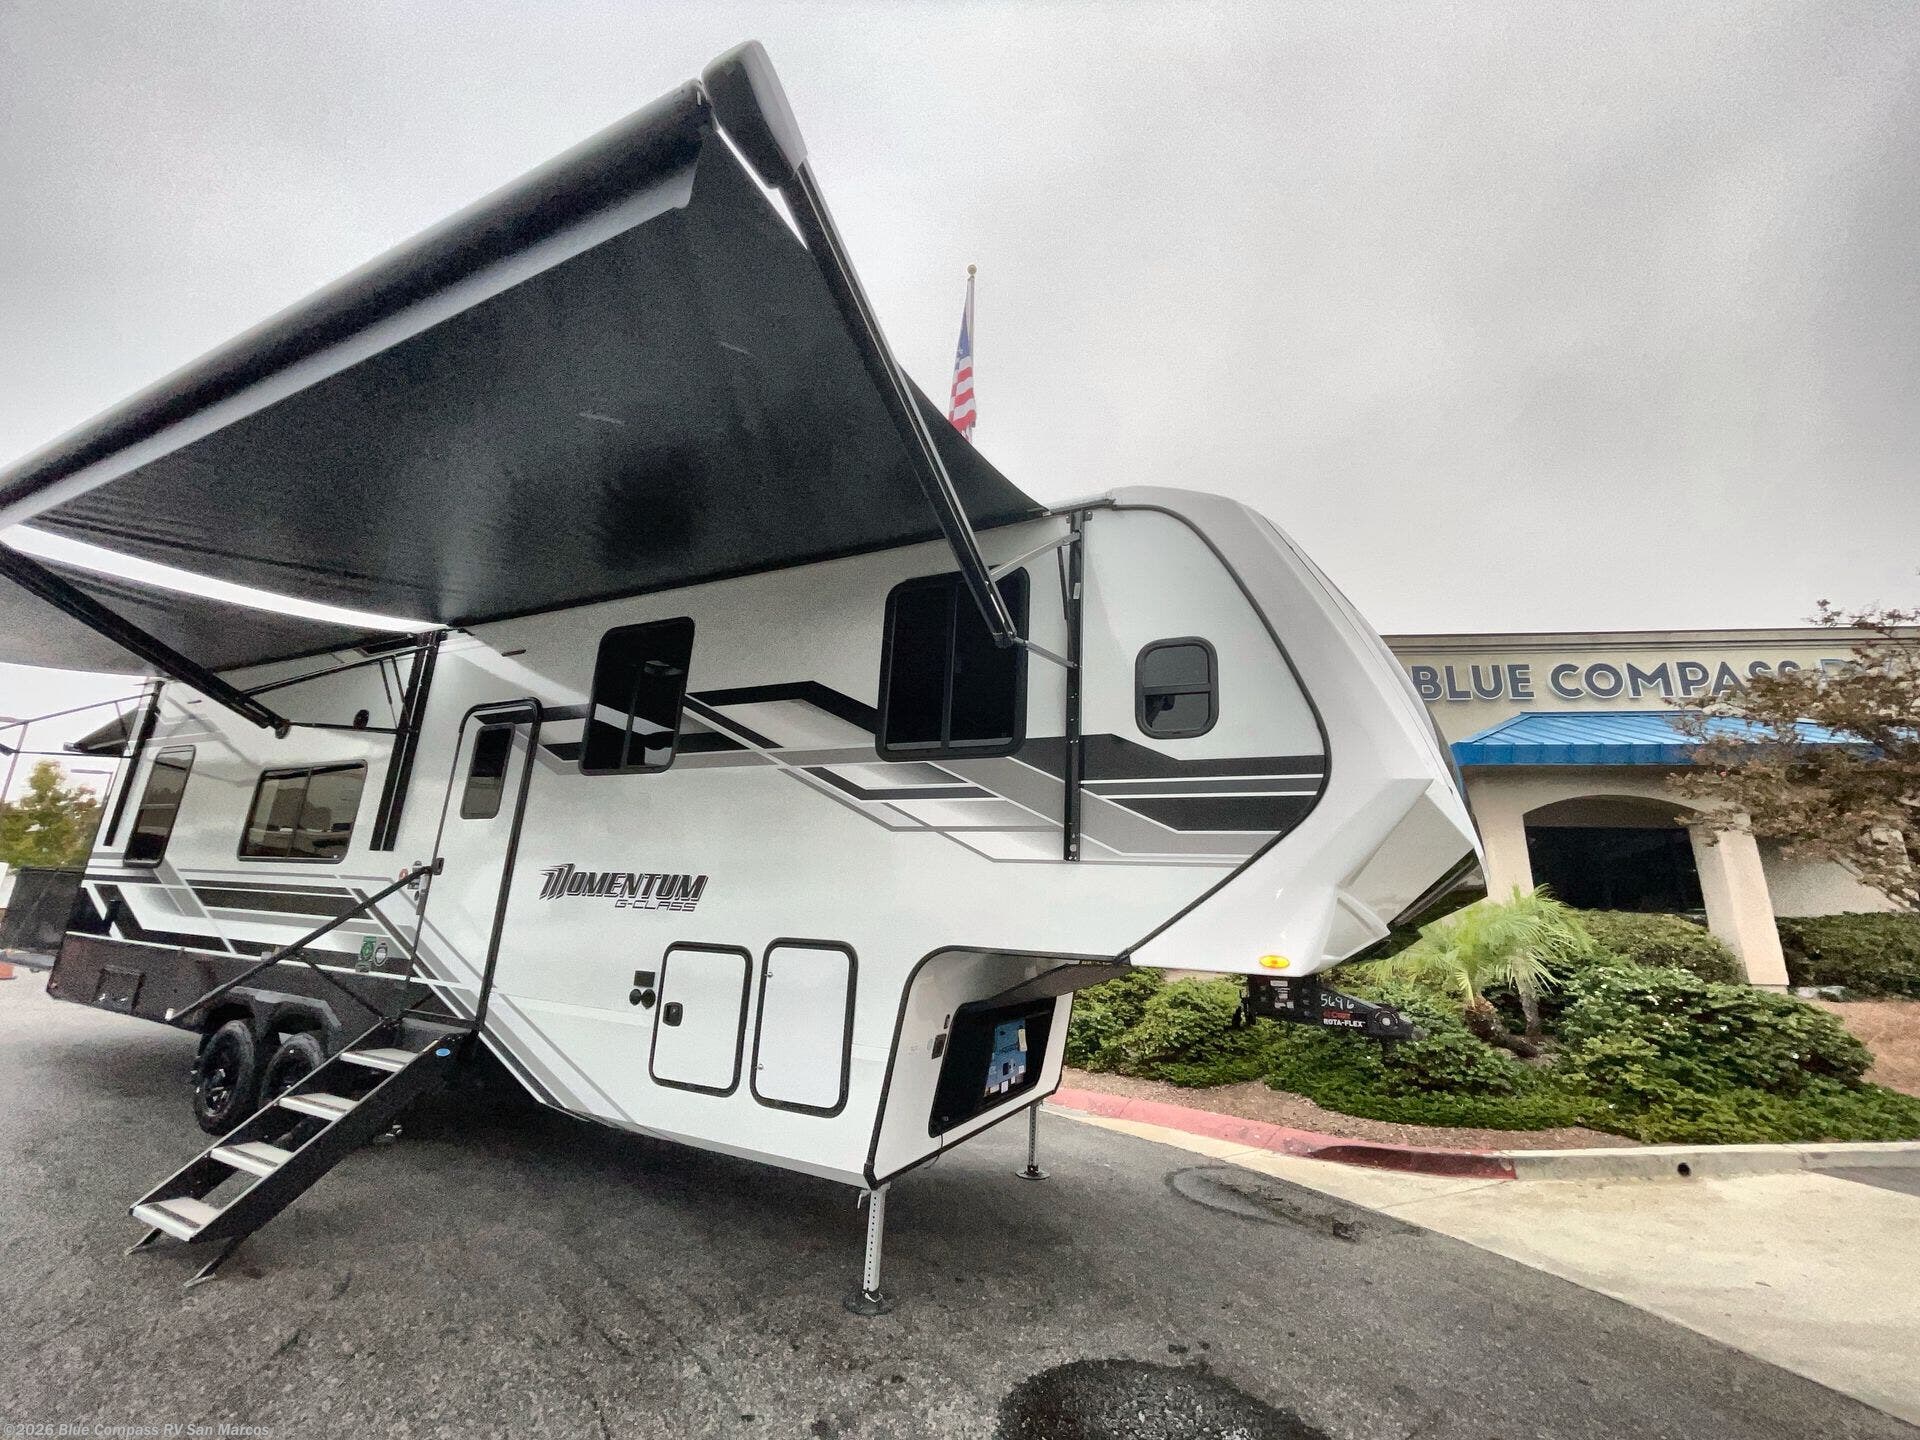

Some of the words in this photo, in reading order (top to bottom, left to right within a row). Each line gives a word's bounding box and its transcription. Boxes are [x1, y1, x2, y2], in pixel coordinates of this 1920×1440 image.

[1411, 664, 1535, 700] BLUE
[539, 863, 709, 902] MOMENTUM
[614, 899, 697, 912] G-CLASS
